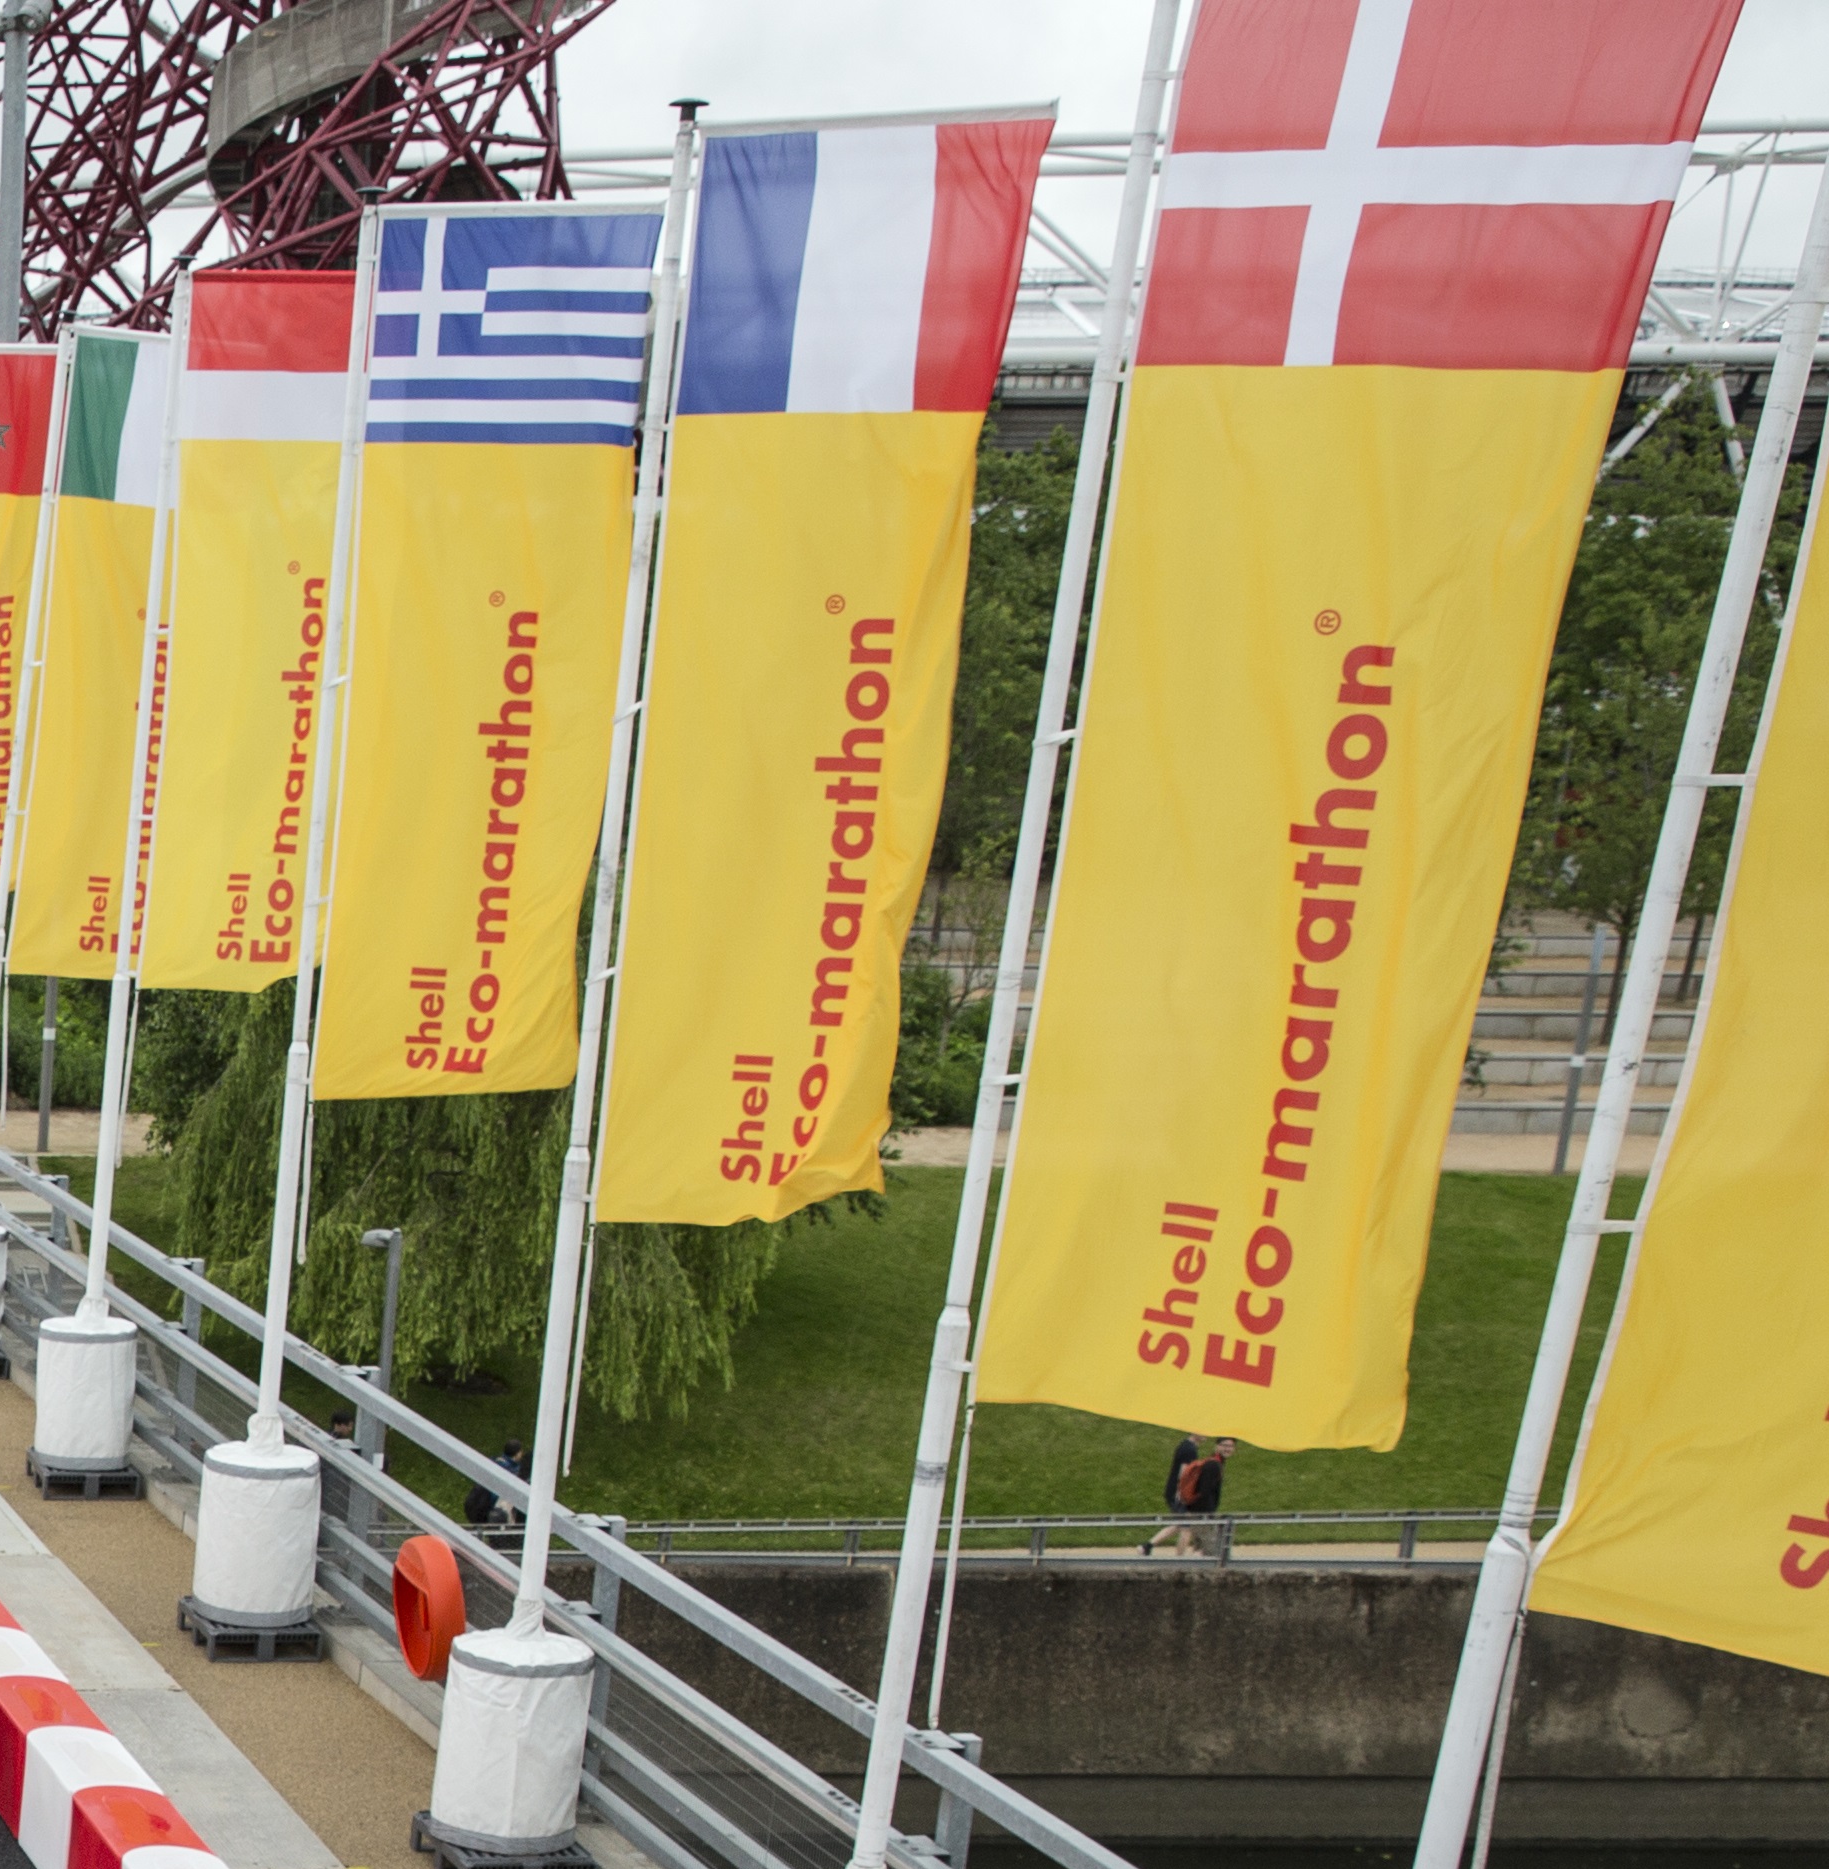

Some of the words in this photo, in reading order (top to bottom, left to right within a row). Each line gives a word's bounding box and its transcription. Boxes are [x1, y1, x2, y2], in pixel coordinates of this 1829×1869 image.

[249, 577, 326, 963] Eco-marathon
[442, 609, 540, 1074] Eco-marathon
[80, 876, 111, 952] Shell
[217, 873, 251, 961] Shell
[767, 618, 896, 1187] Eco-marathon
[406, 967, 447, 1072] Shell
[1201, 643, 1397, 1388] Eco-marathon
[719, 1054, 775, 1184] Shell
[1136, 1201, 1219, 1370] Shell
